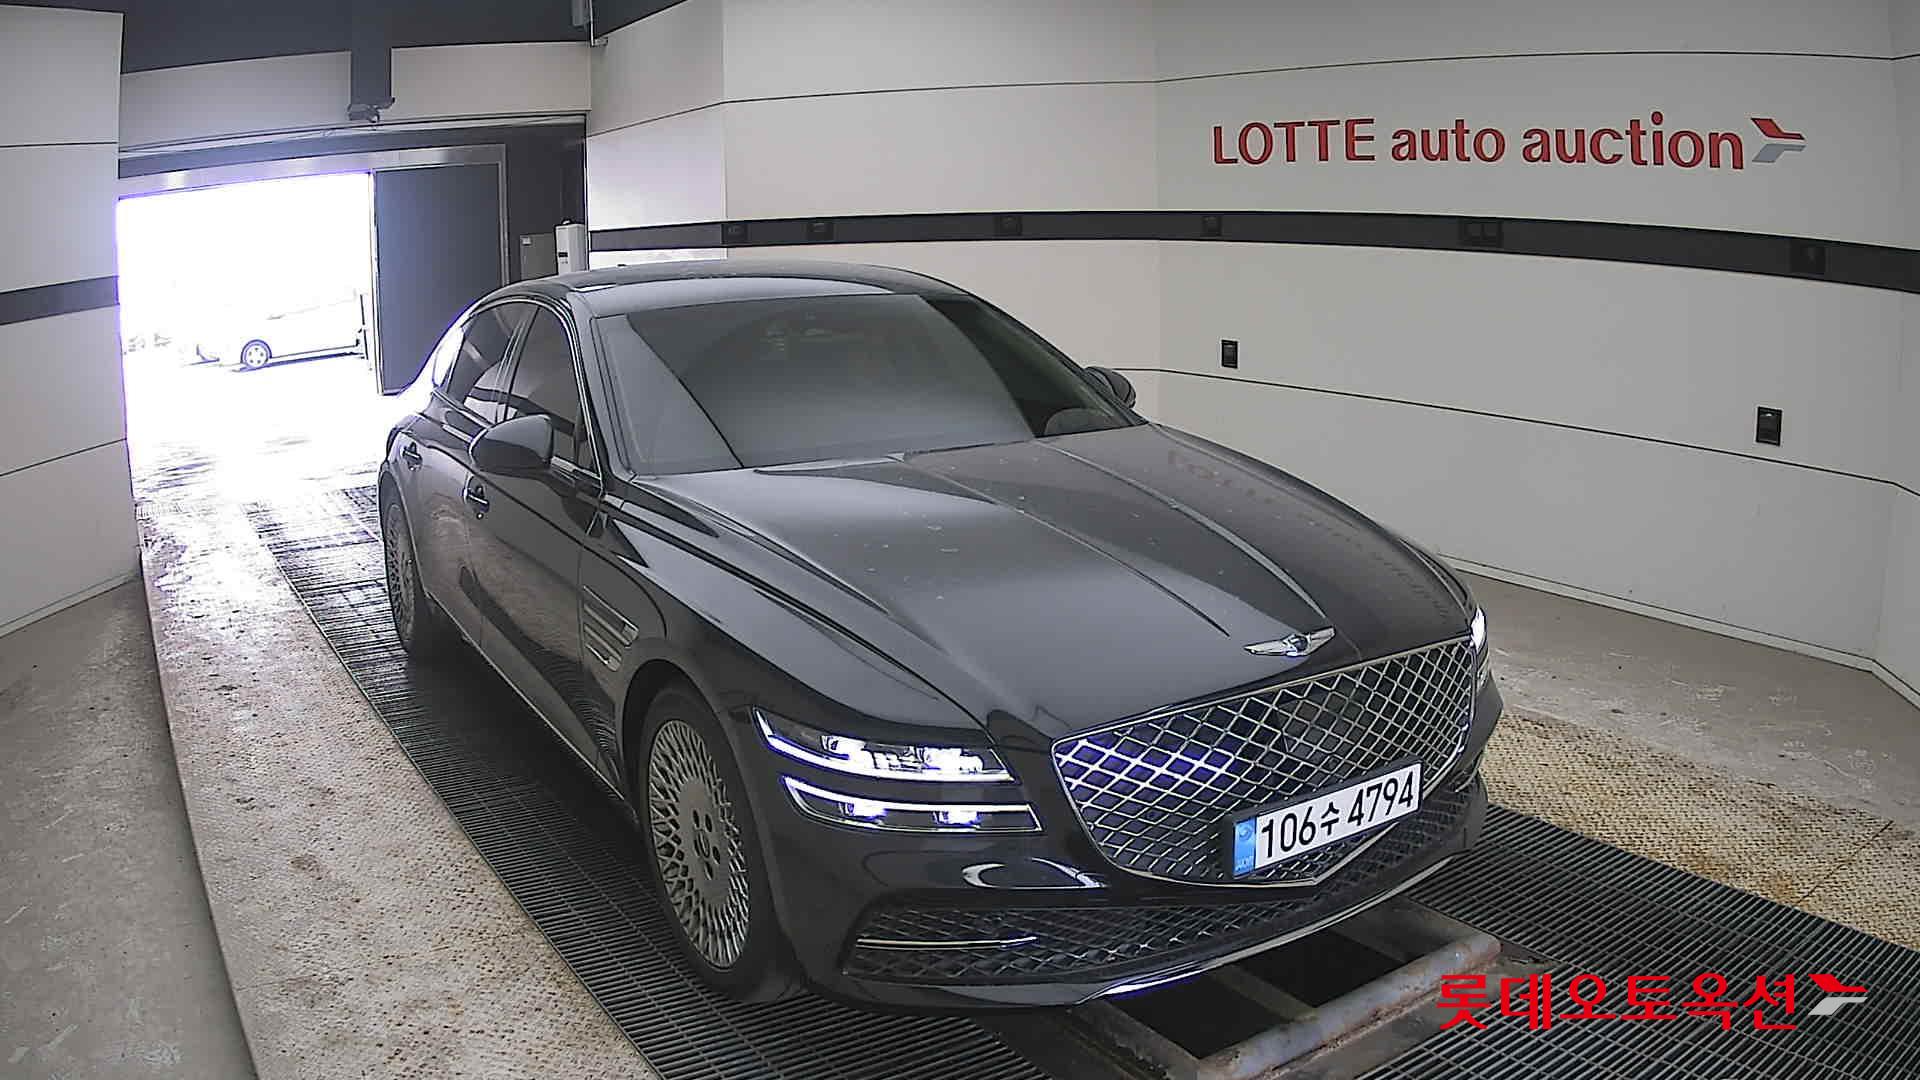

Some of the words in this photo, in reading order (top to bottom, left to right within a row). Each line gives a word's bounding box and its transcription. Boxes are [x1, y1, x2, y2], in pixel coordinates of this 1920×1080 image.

[1213, 118, 1376, 165] LOTTE
[1391, 118, 1506, 163] auto
[1521, 111, 1744, 170] auction
[1261, 802, 1340, 858] 106수
[1348, 771, 1414, 826] 4794
